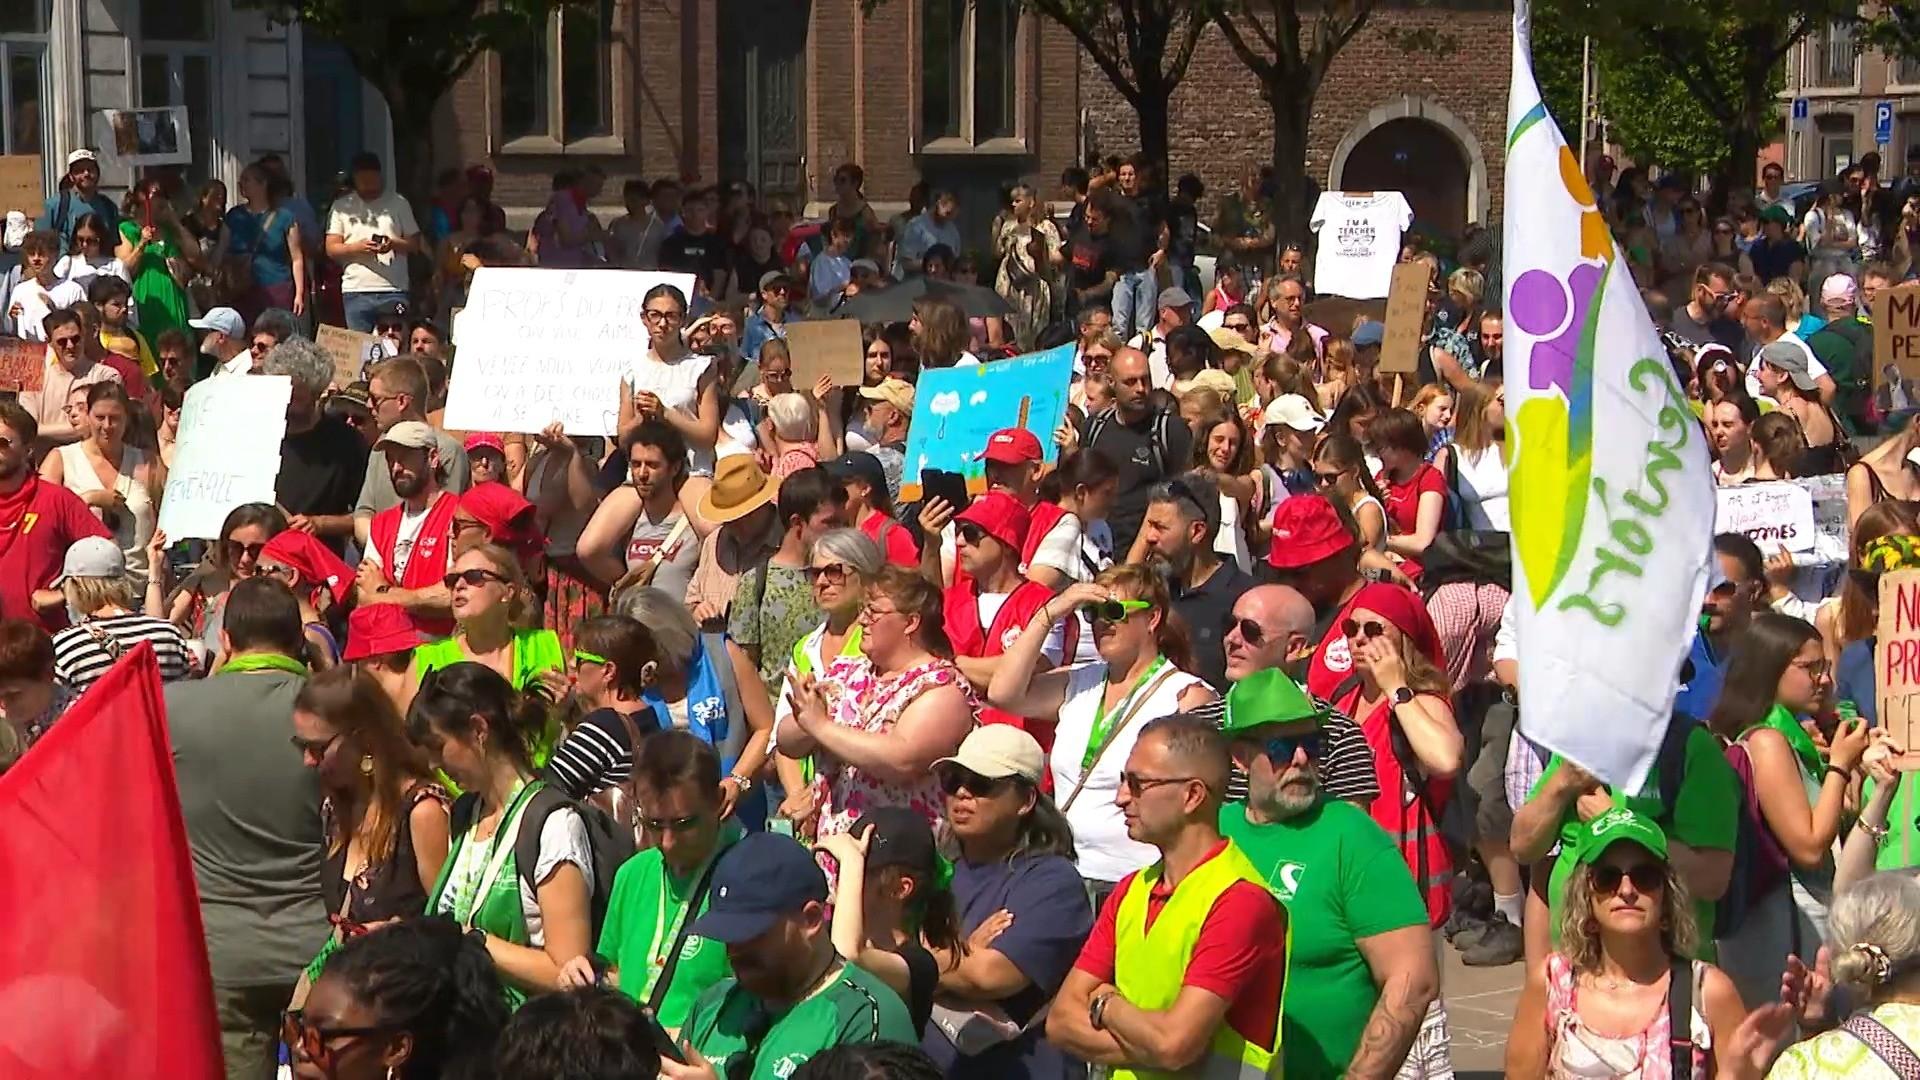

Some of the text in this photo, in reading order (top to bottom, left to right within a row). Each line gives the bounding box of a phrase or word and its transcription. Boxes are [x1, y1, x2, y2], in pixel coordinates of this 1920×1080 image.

[1877, 106, 1890, 130] P
[1338, 227, 1376, 235] TEACHER
[23, 512, 39, 535] 7
